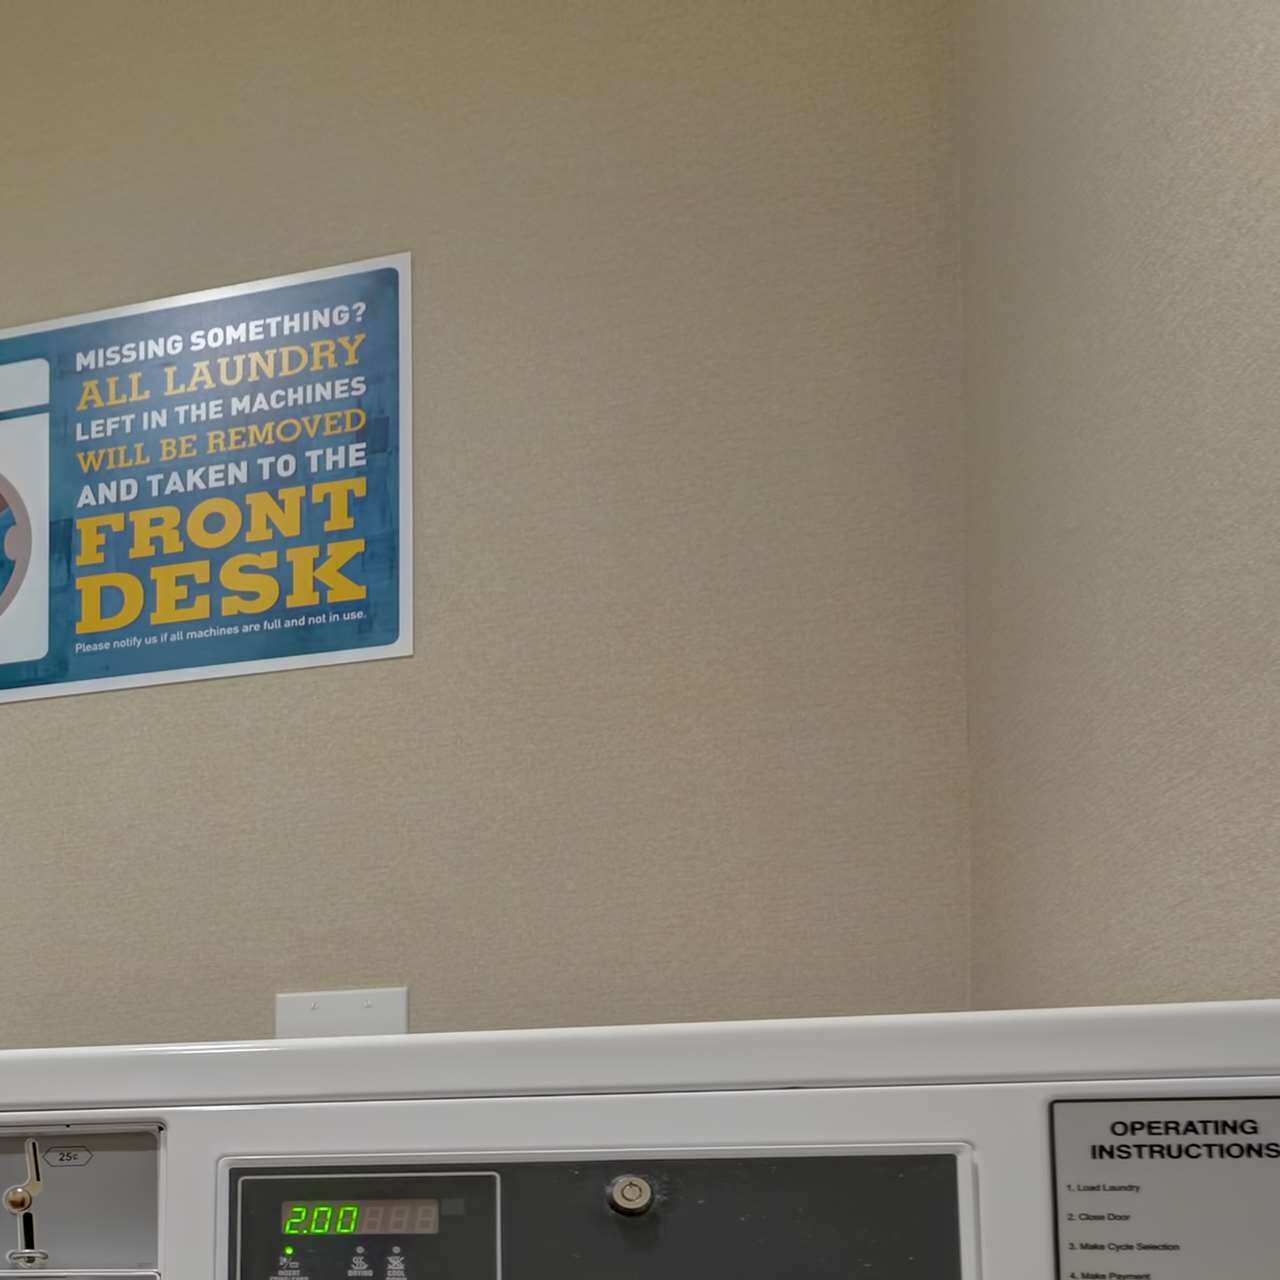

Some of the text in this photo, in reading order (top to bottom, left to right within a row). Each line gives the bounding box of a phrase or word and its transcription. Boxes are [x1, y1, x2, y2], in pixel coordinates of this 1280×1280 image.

[77, 302, 366, 372] MISSING SOMETHING?
[77, 335, 366, 411] ALL LAUNDRY
[77, 377, 366, 440] LEFT IN THE MACHINES
[77, 409, 366, 474] WILL BE REMOVED
[77, 443, 367, 508] AND TAKEN TO THE
[76, 477, 366, 566] FRONT
[76, 541, 366, 634] DESK
[76, 611, 366, 654] Please notify us if all machines are full and not in use.
[1091, 1143, 1280, 1159] INSTRUCTIONS
[1110, 1119, 1258, 1136] OPERATING
[1103, 1184, 1140, 1193] Laundry
[285, 1206, 358, 1234] 2.00
[1108, 1243, 1134, 1251] Cycle
[1109, 1273, 1151, 1280] Payment
